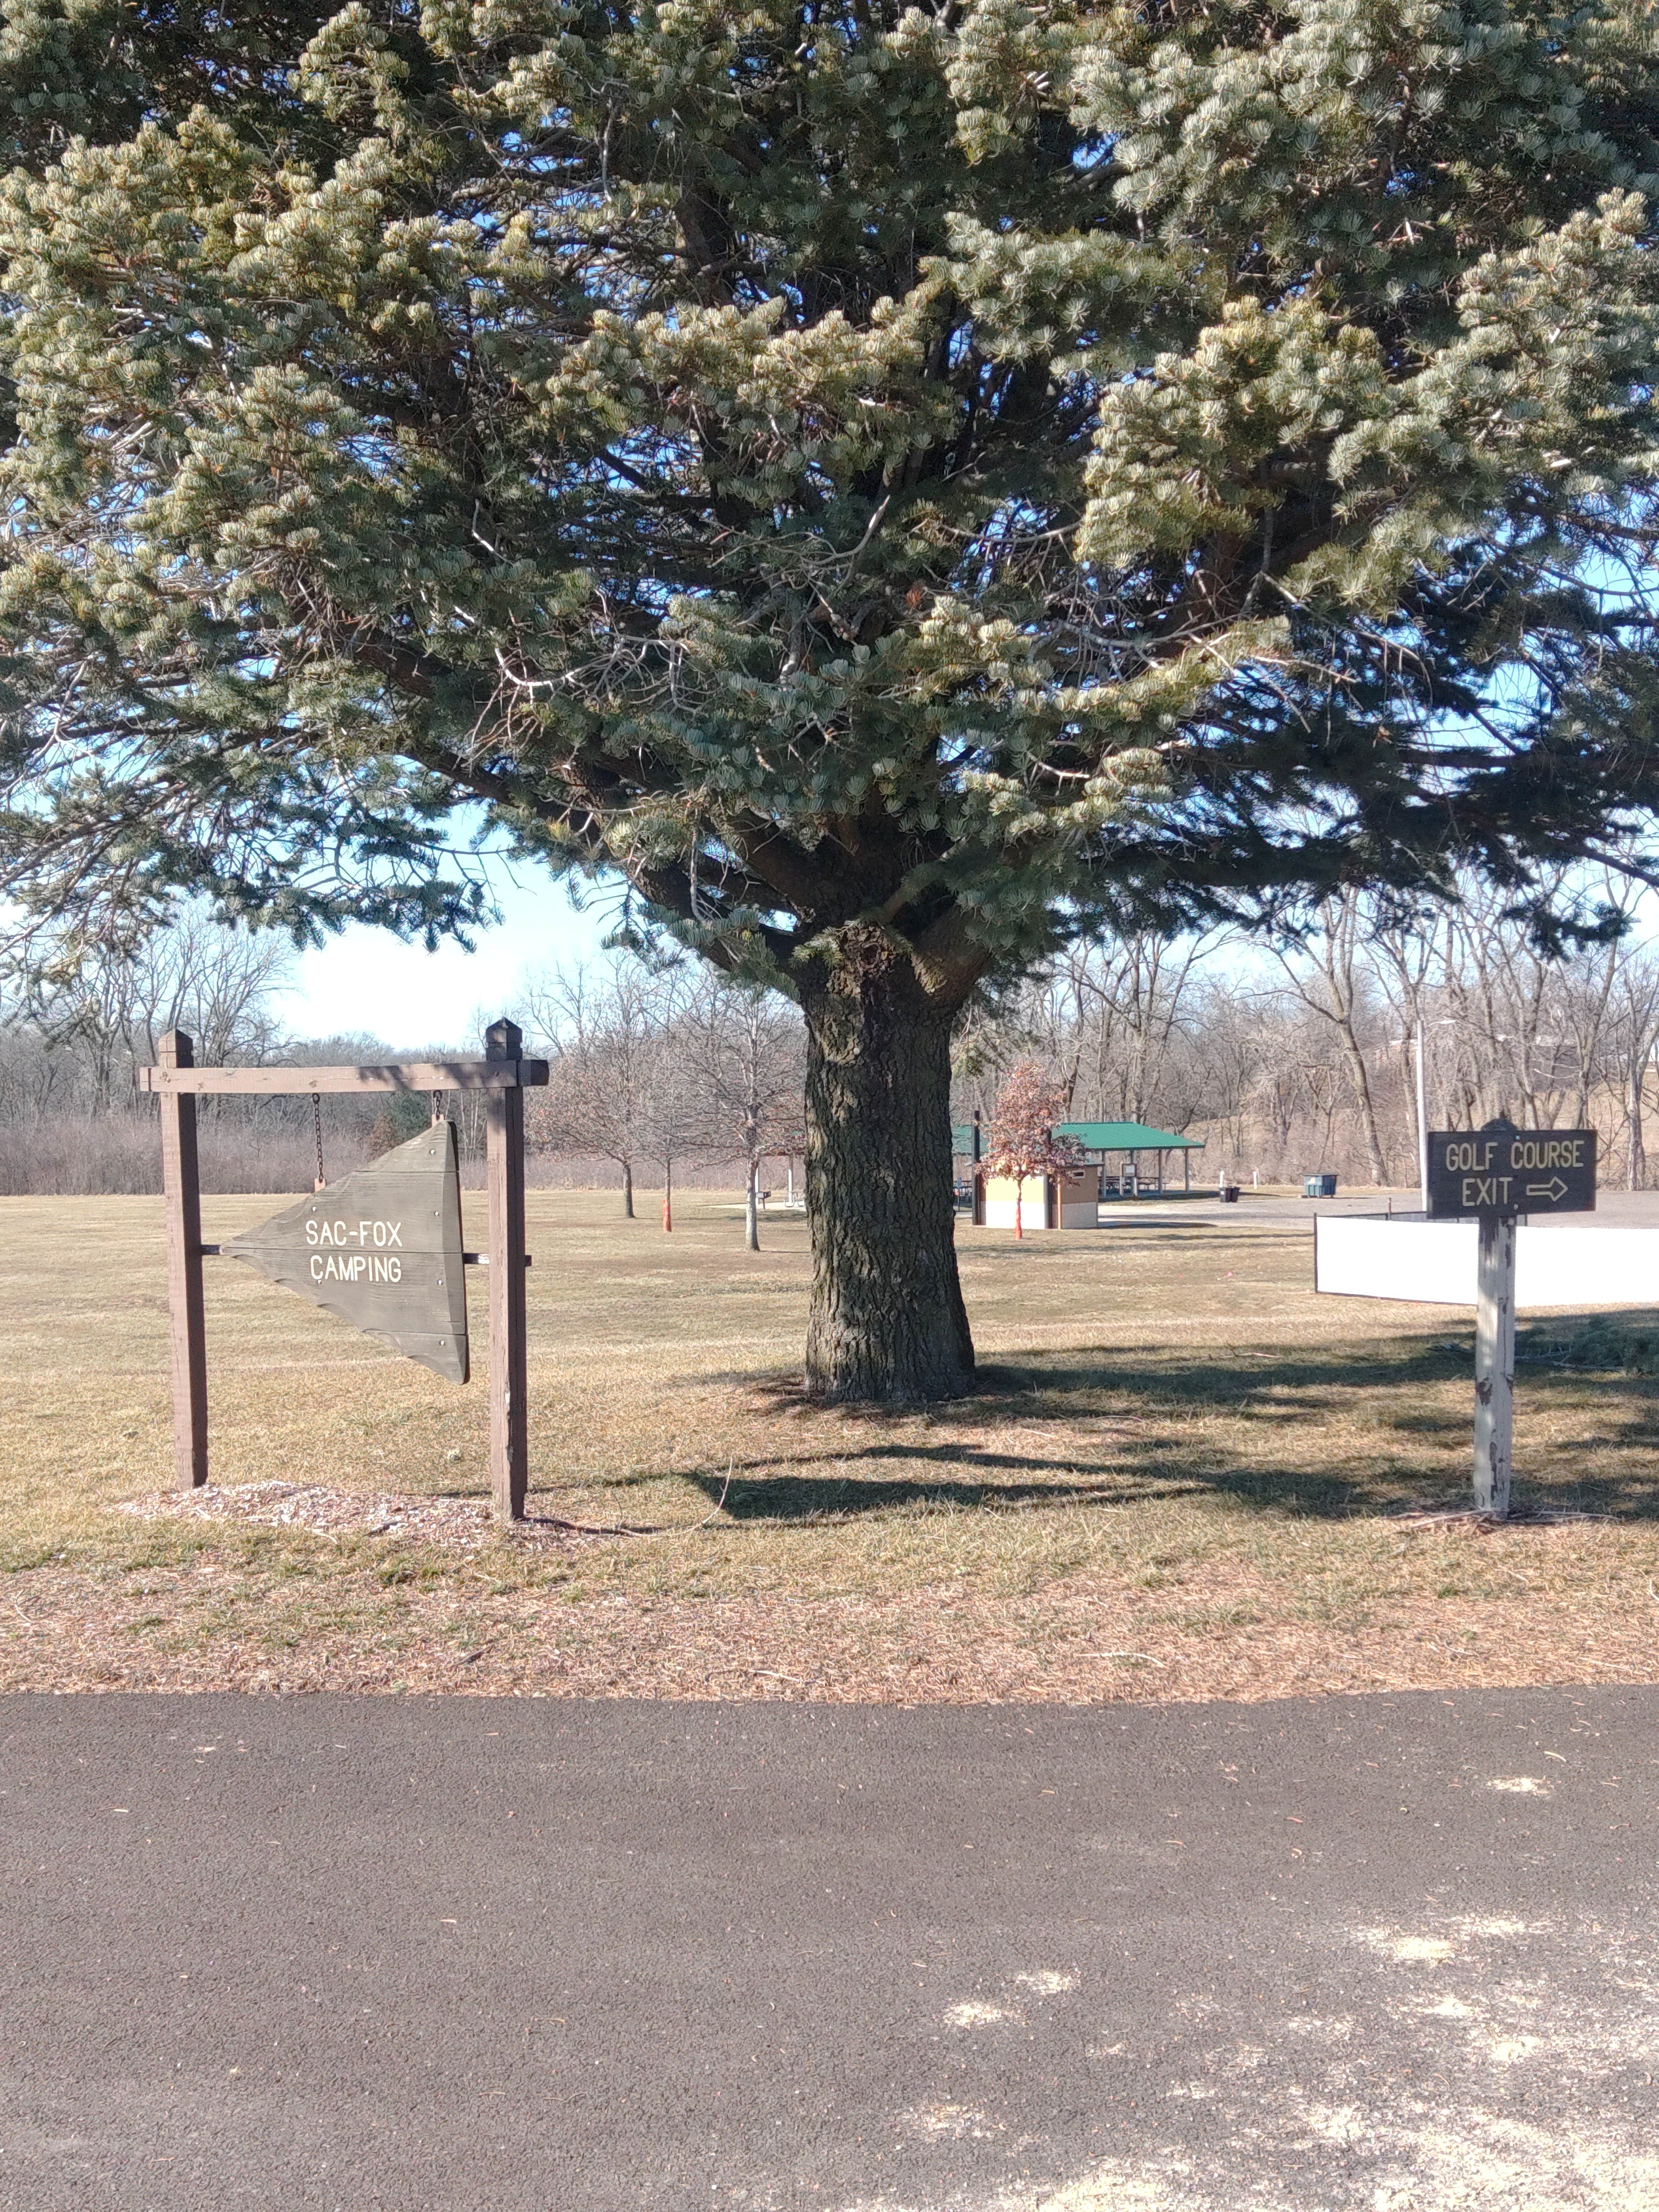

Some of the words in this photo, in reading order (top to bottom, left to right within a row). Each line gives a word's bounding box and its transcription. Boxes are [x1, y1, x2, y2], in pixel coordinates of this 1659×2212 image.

[1446, 1142, 1498, 1171] GOLF
[1511, 1140, 1584, 1169] COURSE
[1462, 1177, 1513, 1206] EXIT
[306, 1220, 402, 1247] SAC-FOX
[310, 1255, 401, 1283] CAMPING
